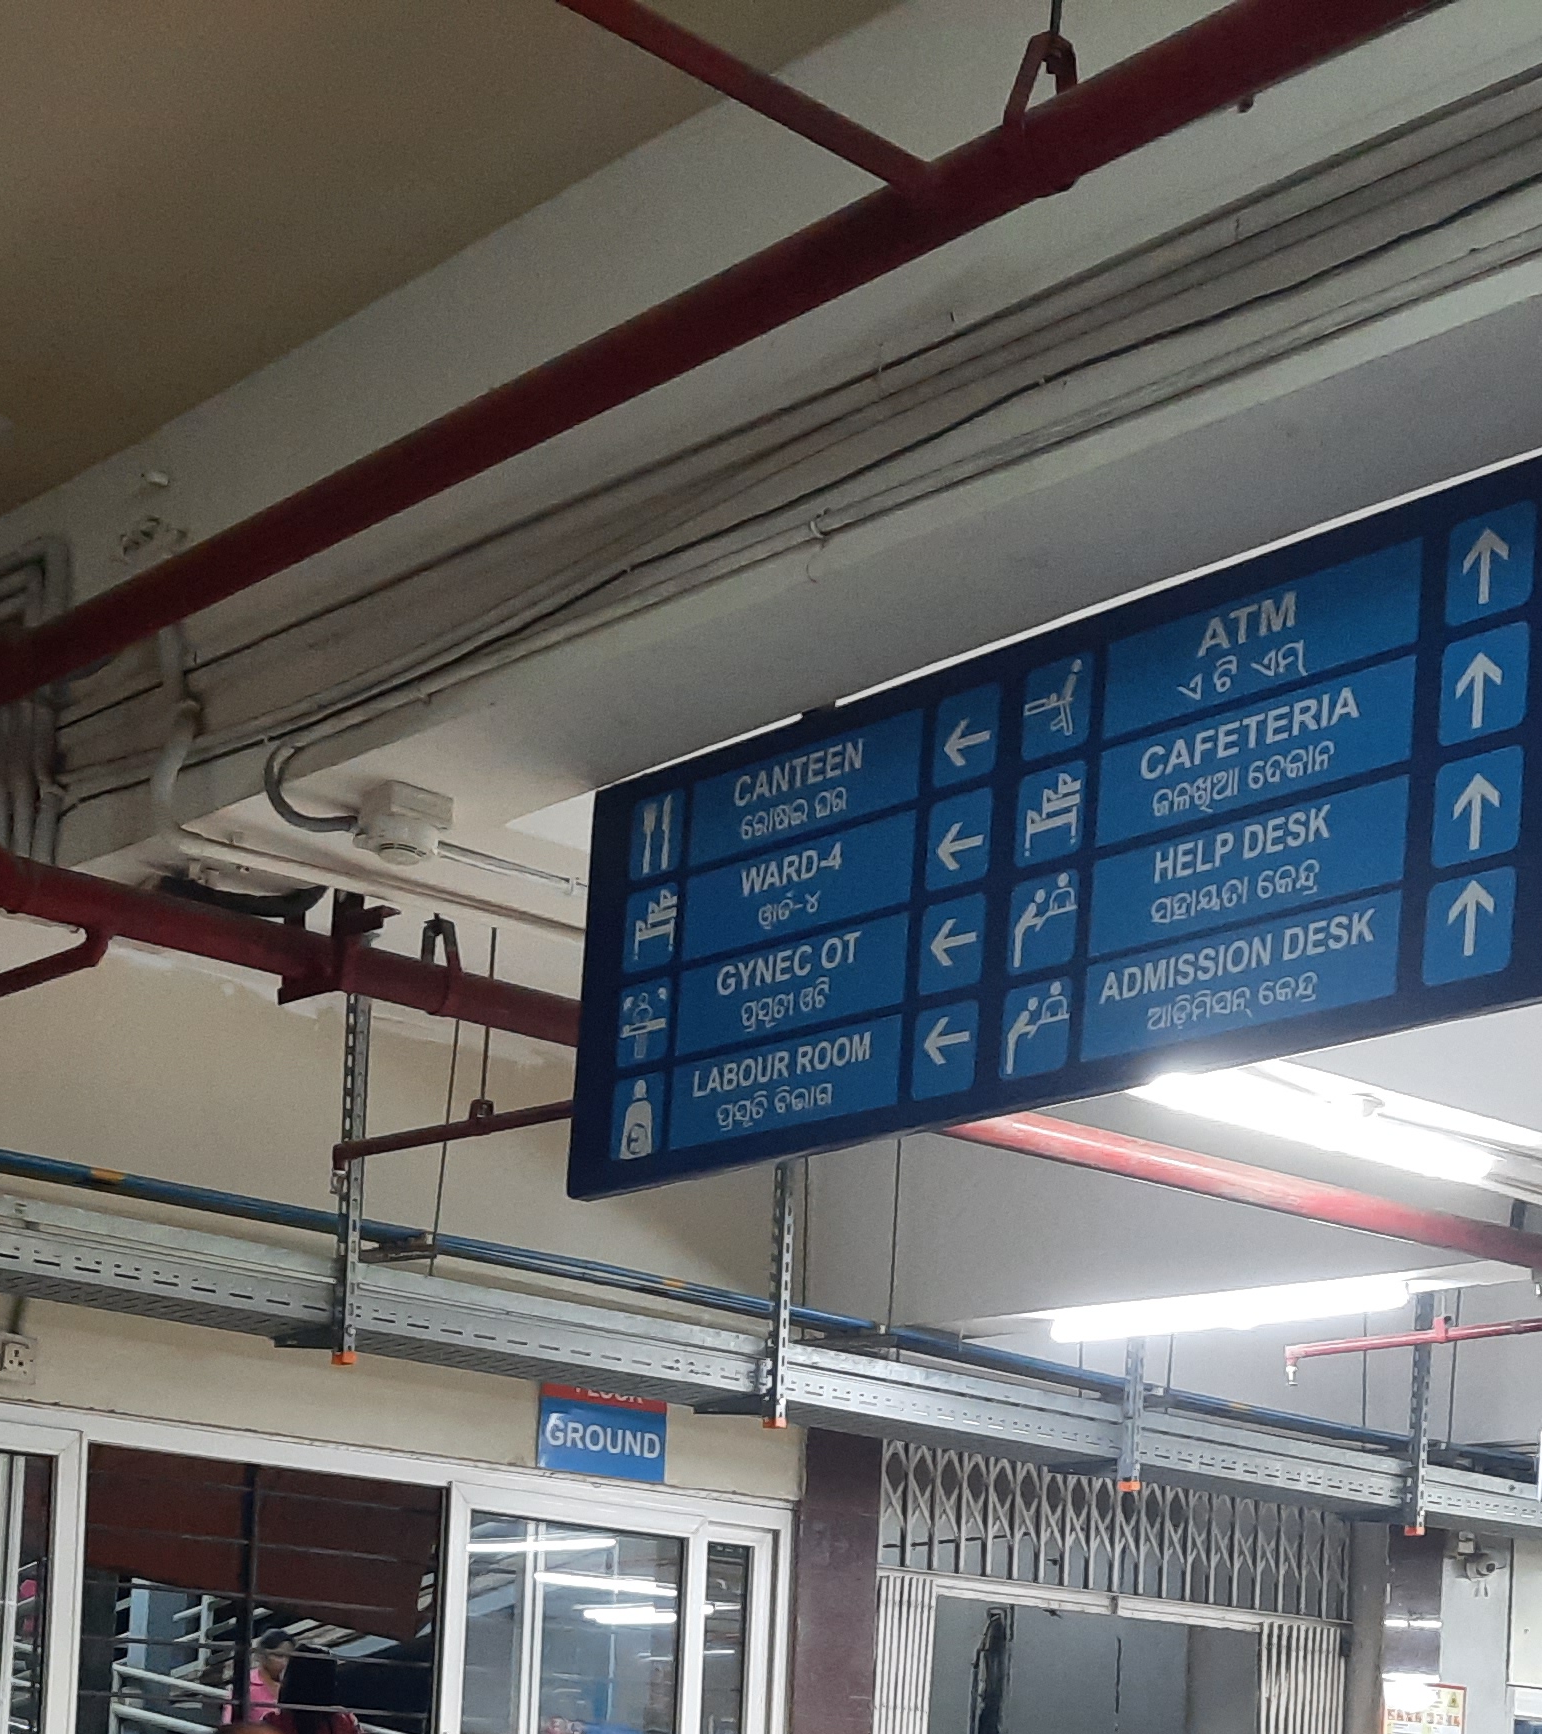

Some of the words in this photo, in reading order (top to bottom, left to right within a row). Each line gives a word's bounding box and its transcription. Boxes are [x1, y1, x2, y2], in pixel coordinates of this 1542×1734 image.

[1197, 591, 1298, 658] ATM
[1213, 655, 1238, 692] ଟି
[1140, 686, 1360, 780] CAFETERIA
[733, 738, 865, 807] CANTEEN
[814, 786, 847, 818] ଘର
[740, 841, 842, 897] WARD-4
[1153, 831, 1235, 883] HELP
[1242, 804, 1331, 860] DESK
[716, 944, 813, 996] GYNEC
[820, 930, 862, 970] OT
[1099, 932, 1274, 1004] ADMISSION
[1282, 907, 1377, 961] DESK
[691, 1050, 790, 1098] LABOUR
[796, 1031, 871, 1075] ROOM
[546, 1414, 661, 1459] GROUND
